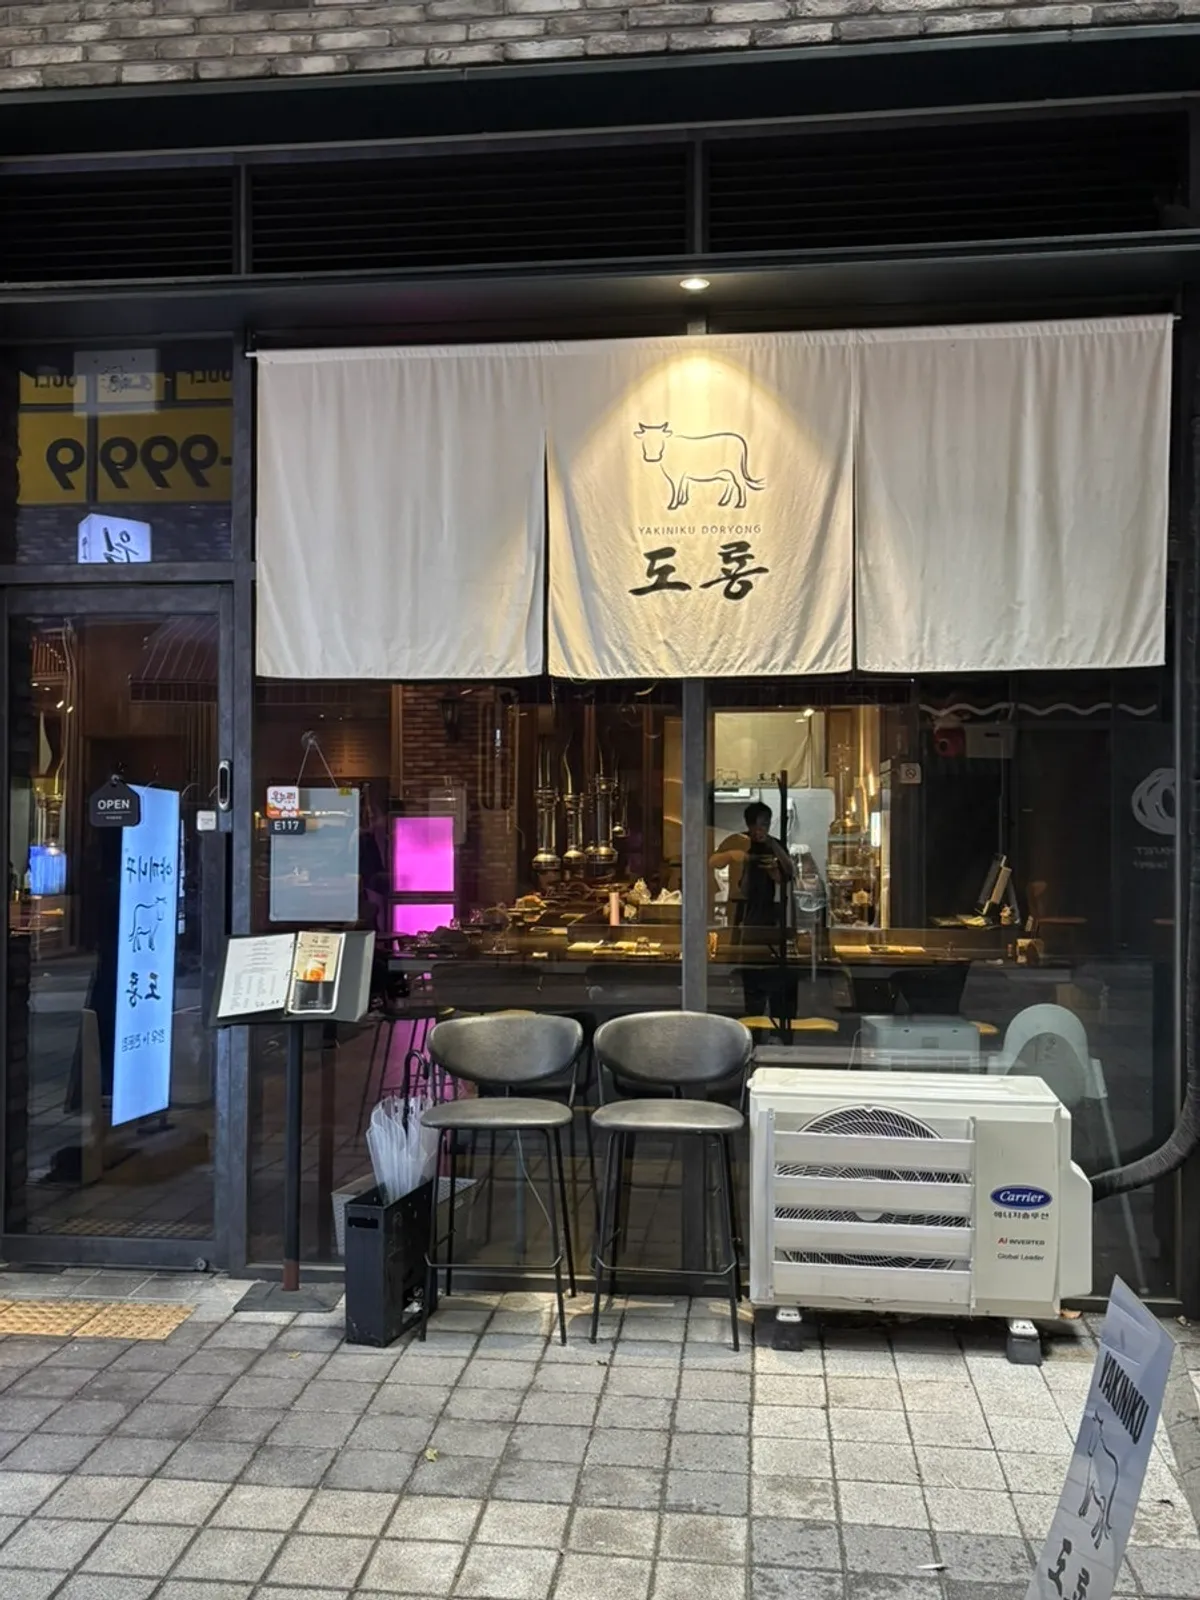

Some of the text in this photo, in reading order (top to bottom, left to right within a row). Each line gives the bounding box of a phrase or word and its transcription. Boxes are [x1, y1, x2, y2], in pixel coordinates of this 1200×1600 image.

[637, 524, 762, 536] YAKINIKU DORYONG
[97, 798, 131, 810] OPEN
[273, 820, 300, 831] E117
[999, 1190, 1045, 1203] Carrier
[997, 1252, 1044, 1261] Global Leader
[1098, 1350, 1150, 1446] YAKINIKU
